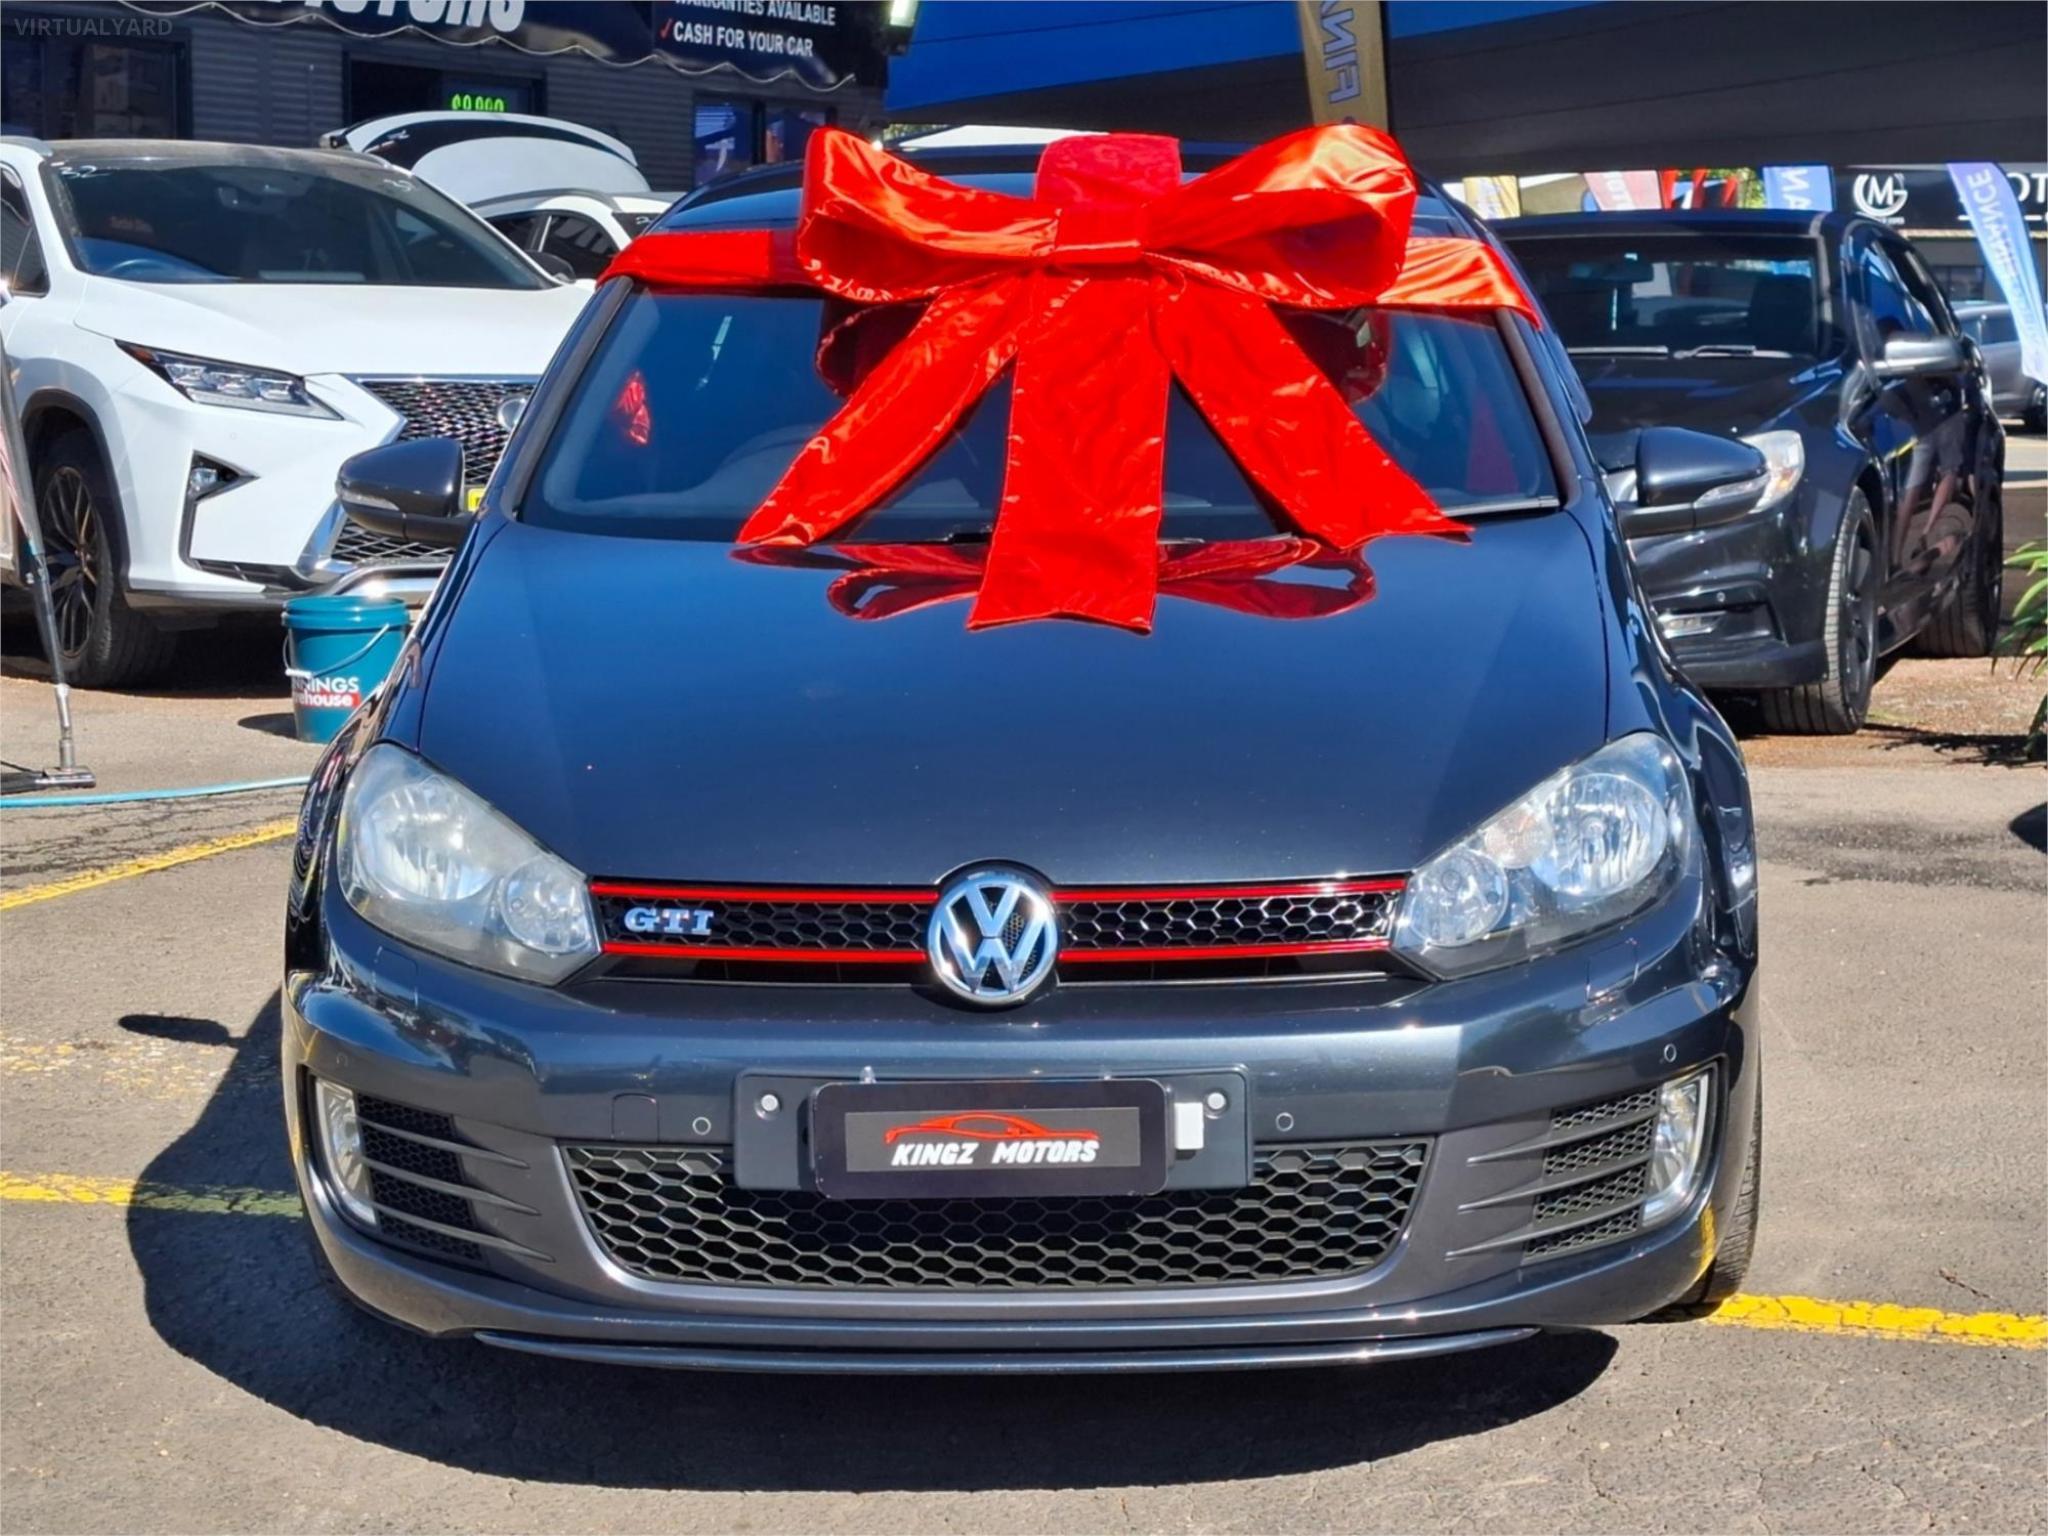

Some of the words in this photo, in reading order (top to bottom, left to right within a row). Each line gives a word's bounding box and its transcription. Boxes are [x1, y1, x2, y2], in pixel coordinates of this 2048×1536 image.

[767, 0, 836, 26] AVAILABLE
[673, 21, 713, 45] CASH
[716, 27, 745, 49] FOR
[749, 31, 786, 53] YOUR
[786, 36, 814, 57] CAR
[624, 907, 714, 935] GTI
[891, 1142, 979, 1166] KINGZ
[991, 1140, 1100, 1164] MOTORS
